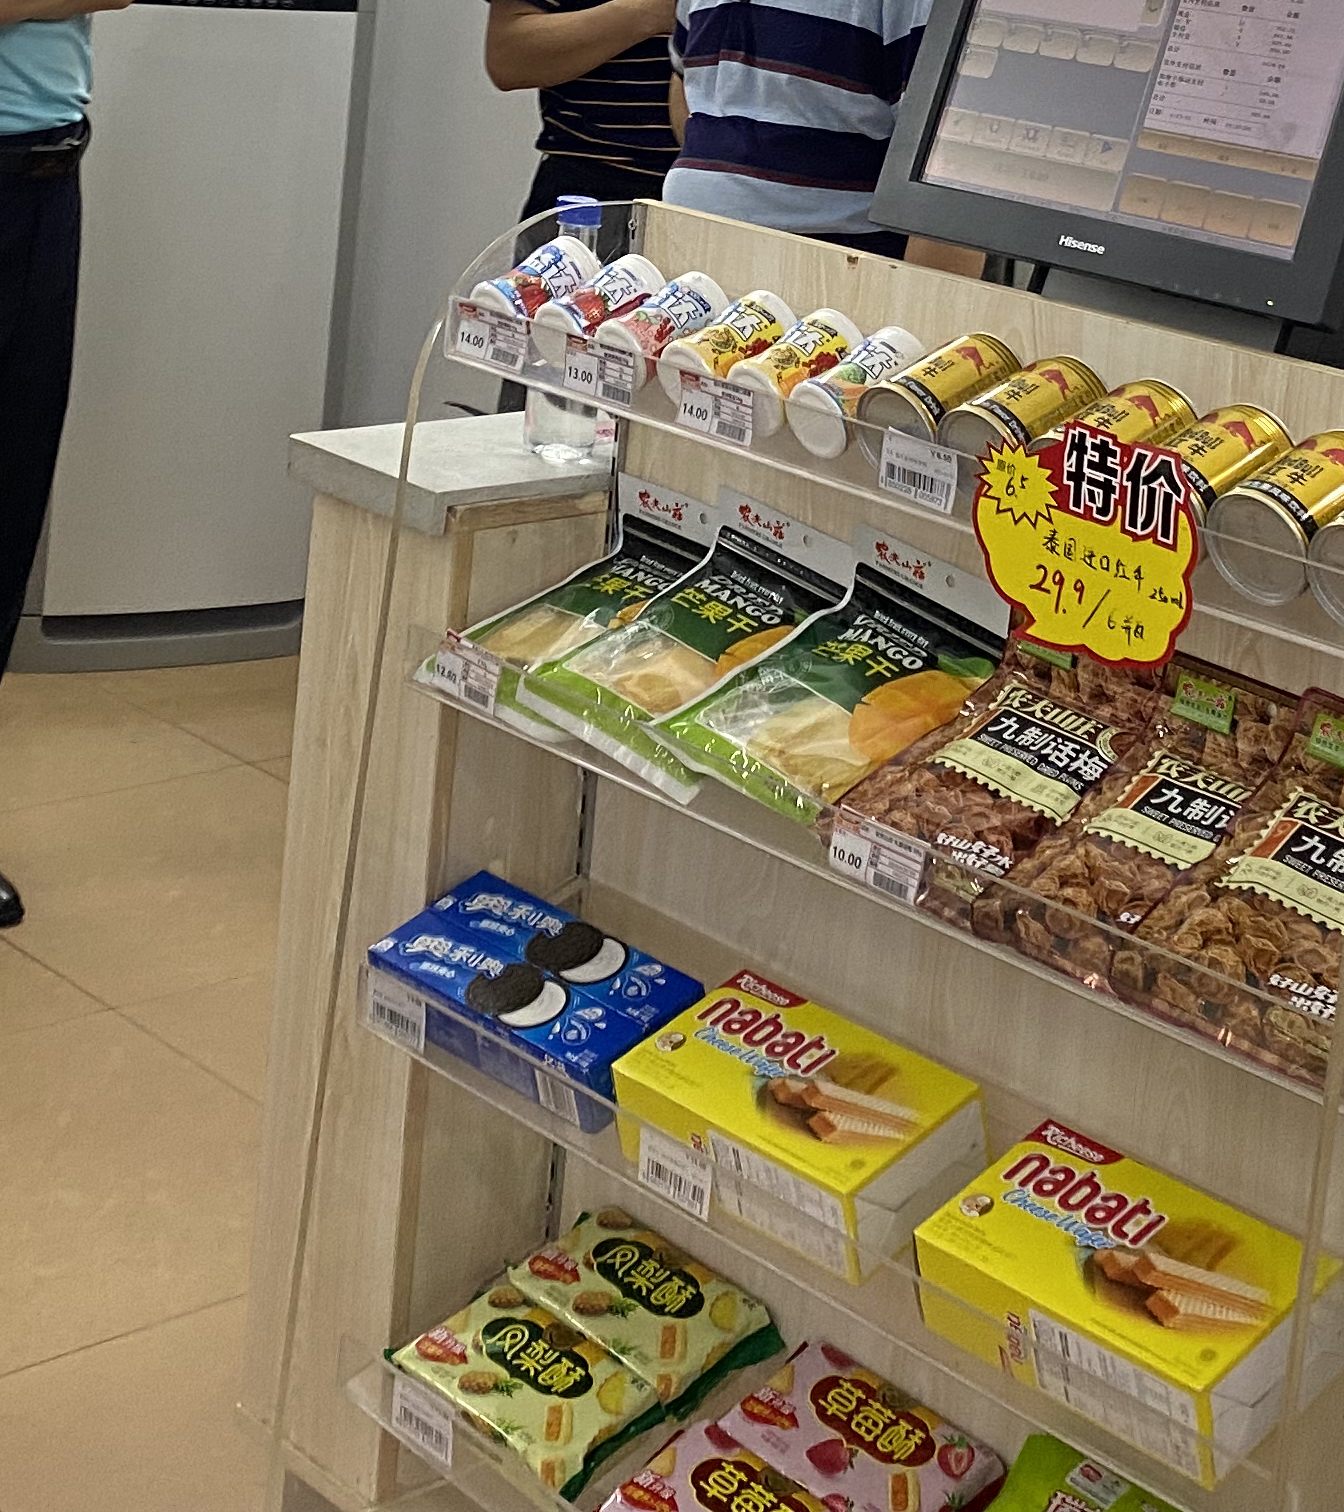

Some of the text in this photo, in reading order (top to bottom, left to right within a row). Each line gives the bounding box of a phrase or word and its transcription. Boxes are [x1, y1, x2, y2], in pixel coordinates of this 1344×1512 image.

[1058, 233, 1106, 257] Hisense
[460, 330, 485, 350] 14.00
[567, 365, 594, 385] 13.00
[682, 402, 709, 422] 14.00
[1064, 426, 1186, 546] 特价
[1042, 528, 1146, 592] 泰国进口红牛
[670, 586, 759, 633] 芒果干
[693, 579, 783, 626] MANGO
[836, 626, 925, 671] MANGO
[987, 715, 1109, 782] 九制话梅
[832, 844, 863, 870] 10.00
[462, 892, 566, 938] 奥利奥
[404, 934, 506, 980] 奥利奥
[695, 996, 840, 1077] nabati
[999, 1150, 1170, 1248] nabati
[818, 1378, 929, 1462] 草莓酥
